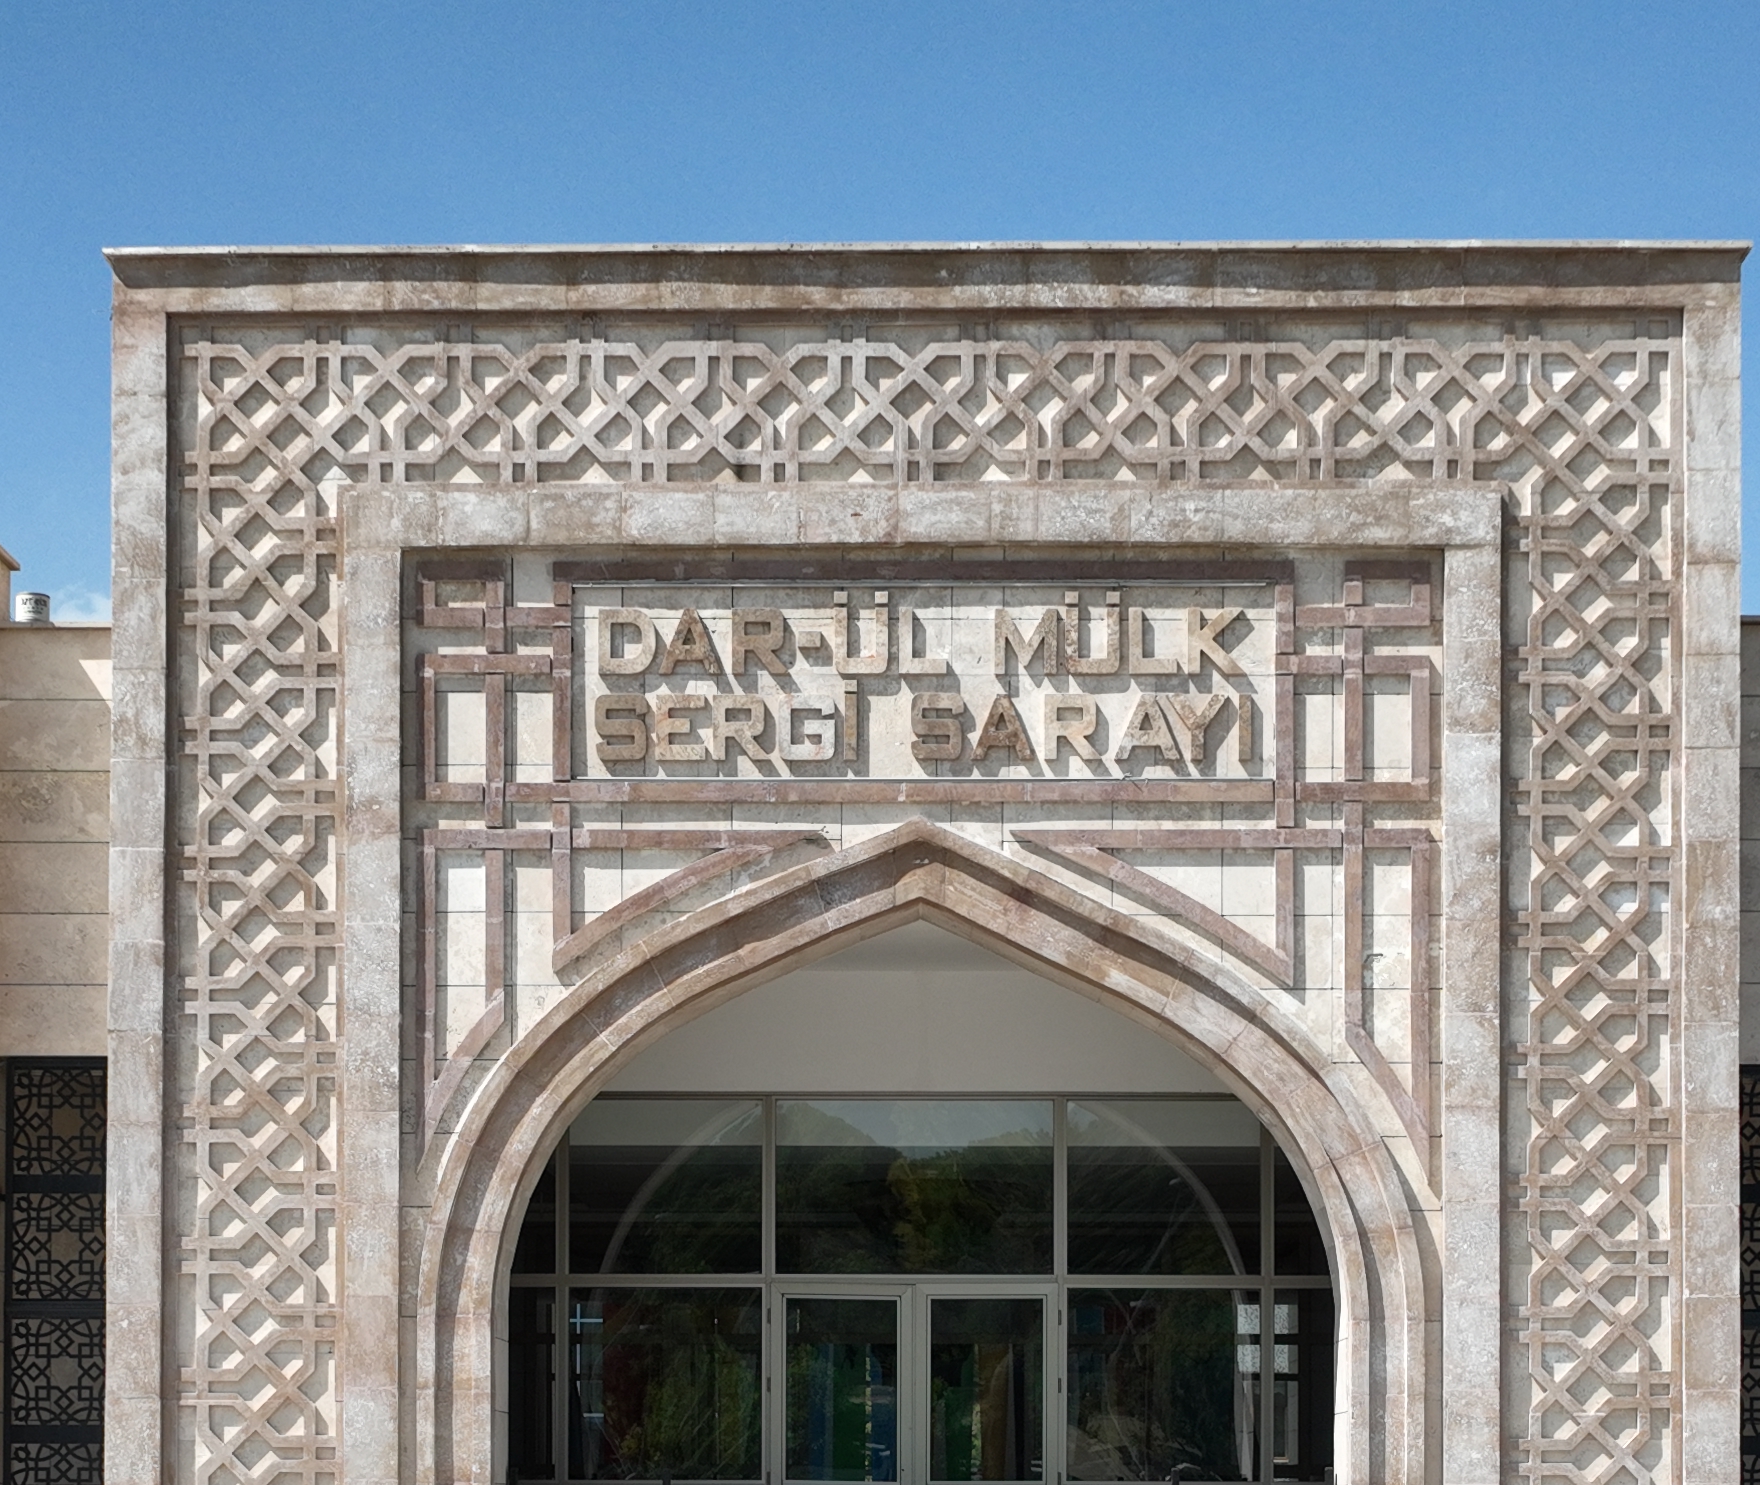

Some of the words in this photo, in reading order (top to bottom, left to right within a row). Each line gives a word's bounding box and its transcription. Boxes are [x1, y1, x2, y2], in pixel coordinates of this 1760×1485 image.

[597, 590, 948, 675] DAR-ÜL
[994, 590, 1247, 675] MÜLK
[594, 679, 858, 761] SERGİ
[910, 692, 1253, 762] SARAYI
